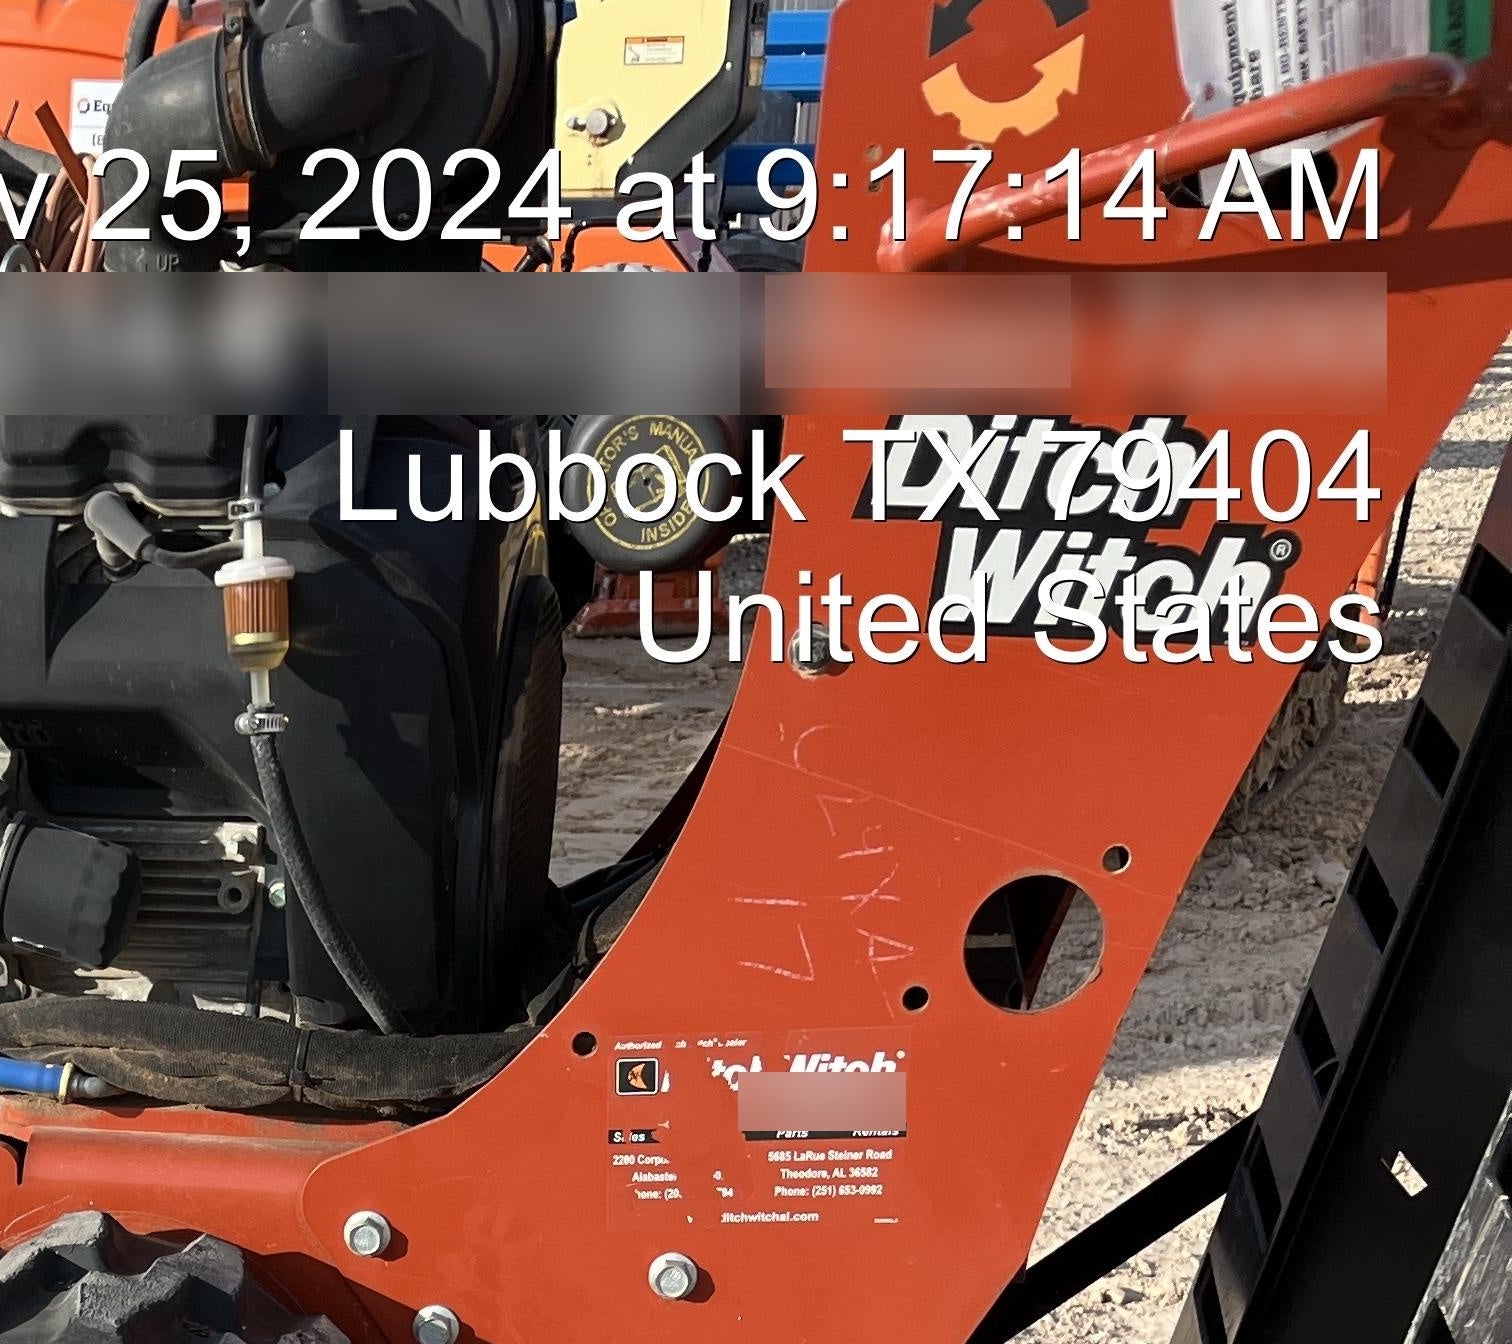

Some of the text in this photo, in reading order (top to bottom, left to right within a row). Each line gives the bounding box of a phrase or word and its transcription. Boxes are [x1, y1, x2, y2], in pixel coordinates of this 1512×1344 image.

[1221, 0, 1246, 107] quipment
[649, 421, 699, 466] MANUA
[614, 1041, 663, 1050] Authorized
[793, 1150, 825, 1162] LaRue
[828, 1149, 864, 1161] Steiner
[865, 1149, 893, 1160] Road
[780, 1168, 831, 1179] Theodore,
[832, 1168, 847, 1178] AL
[774, 1185, 809, 1197] Phone:
[811, 1185, 836, 1198] (251)
